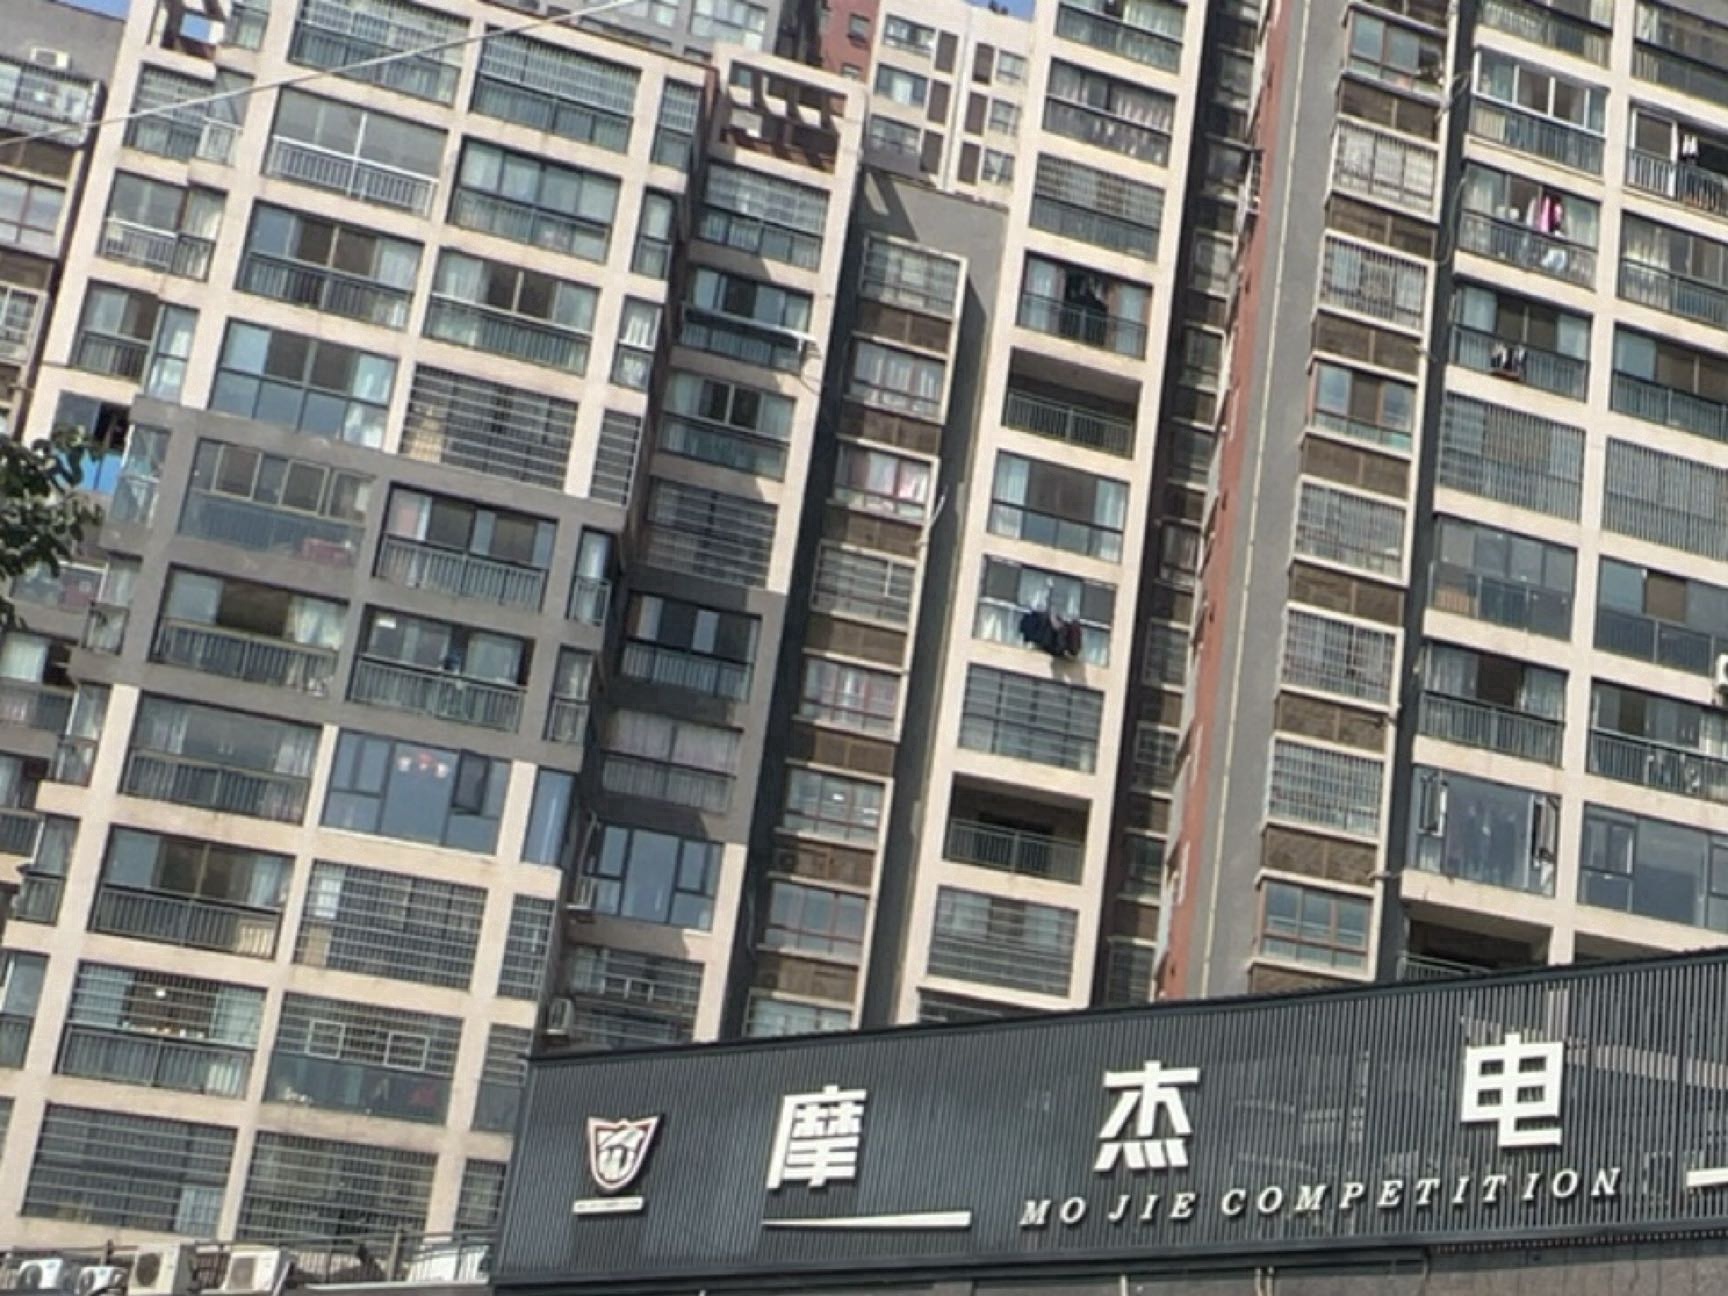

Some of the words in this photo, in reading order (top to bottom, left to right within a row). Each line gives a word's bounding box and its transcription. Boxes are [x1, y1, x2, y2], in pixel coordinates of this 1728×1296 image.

[1019, 1197, 1086, 1226] MO
[1108, 1191, 1197, 1222] JIE
[1221, 1167, 1622, 1217] COMPETITION
